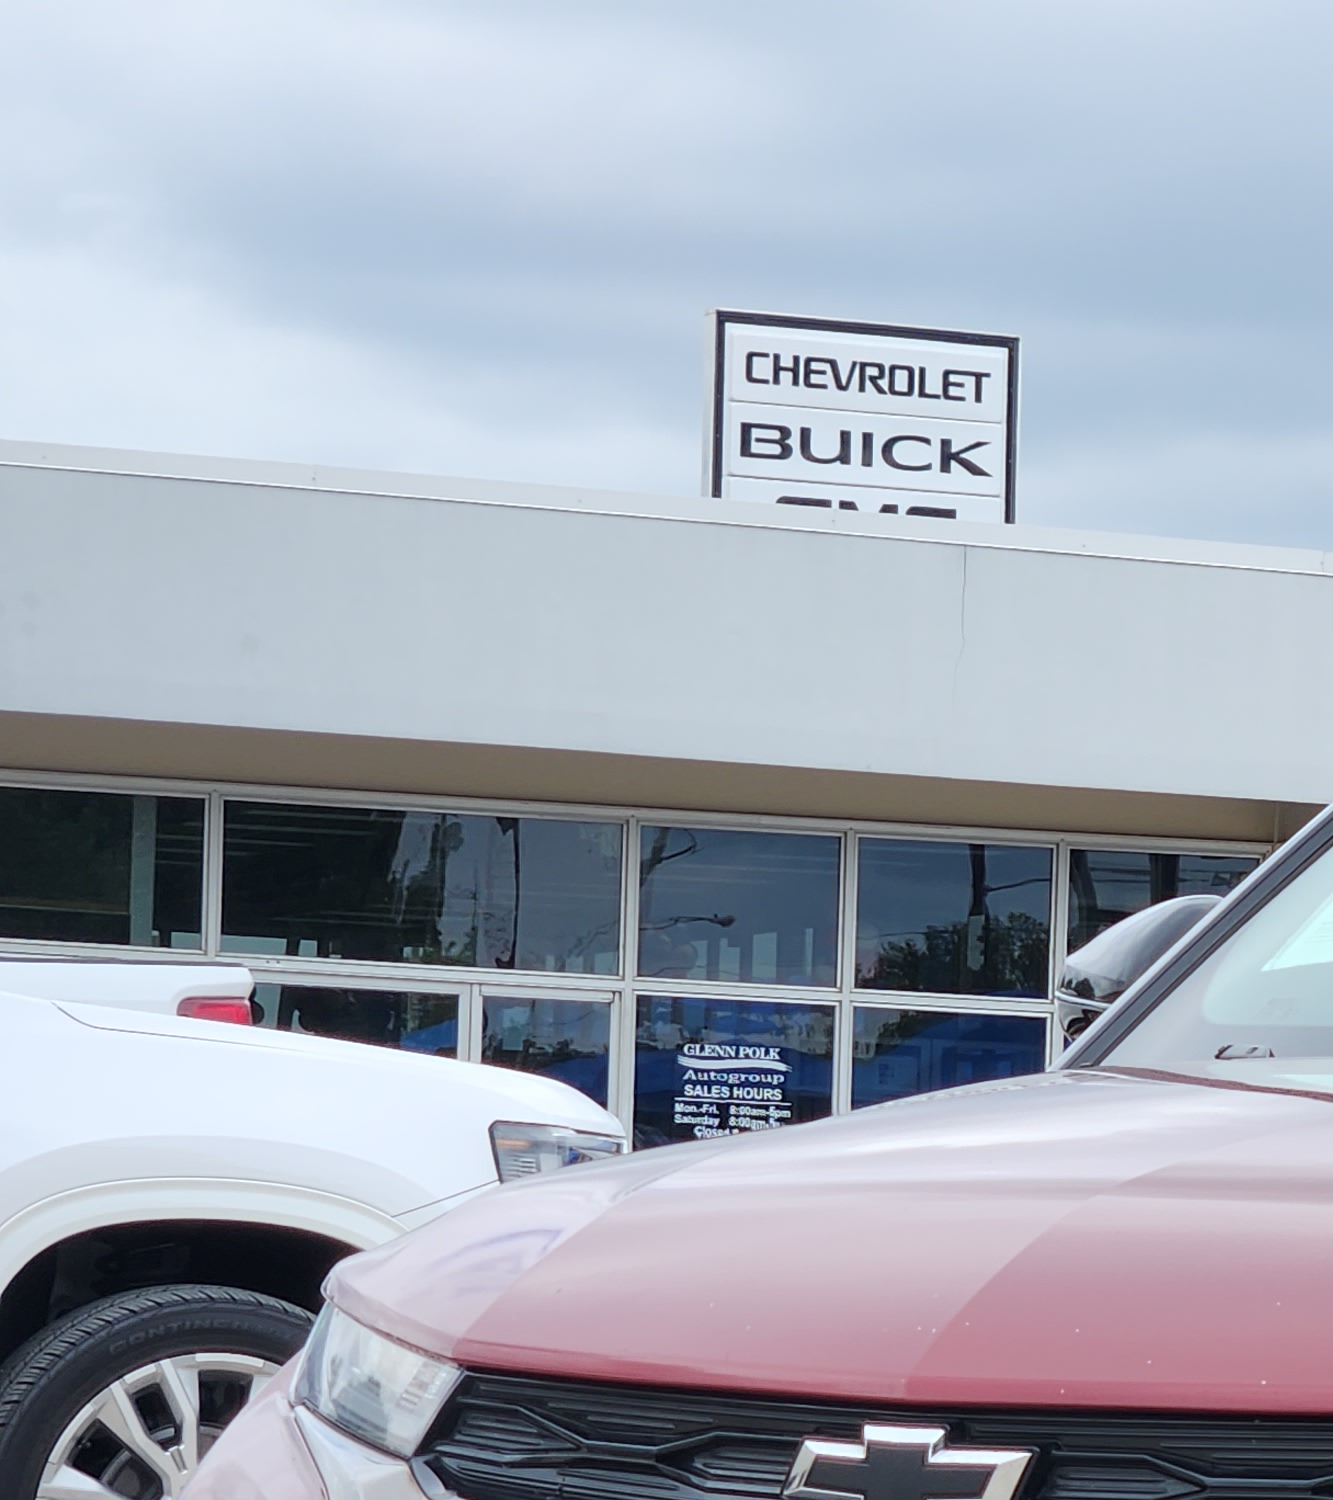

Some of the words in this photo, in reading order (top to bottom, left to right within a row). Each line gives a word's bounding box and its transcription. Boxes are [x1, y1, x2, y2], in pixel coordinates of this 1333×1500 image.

[746, 351, 992, 404] CHEVROLET
[740, 421, 994, 478] BUICK
[683, 1043, 738, 1058] GLENN
[739, 1046, 781, 1060] POLK
[683, 1069, 785, 1085] Autogroup
[684, 1084, 730, 1098] SALES
[733, 1086, 783, 1101] HOURS
[674, 1114, 721, 1128] Saturday
